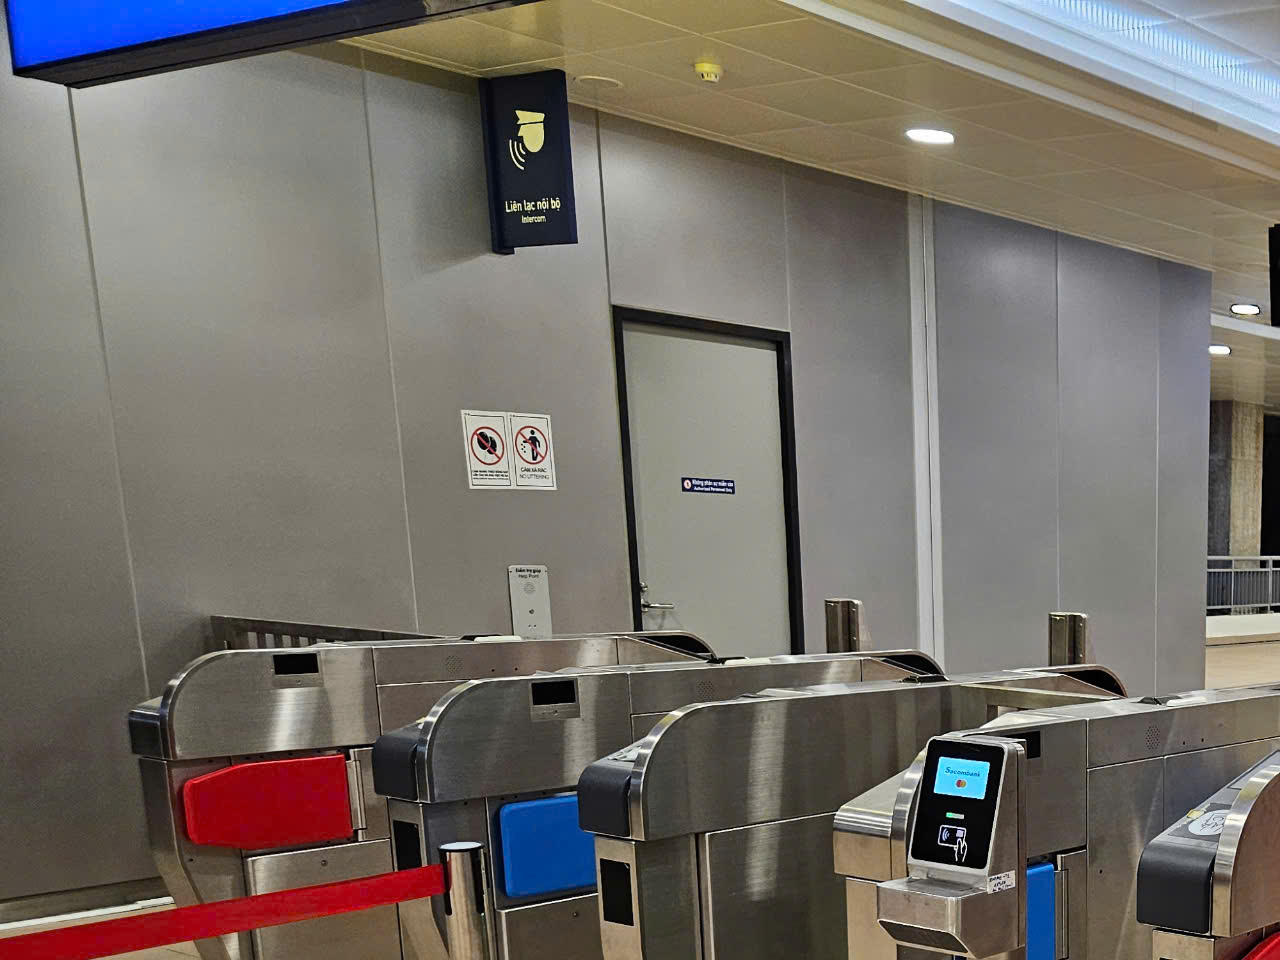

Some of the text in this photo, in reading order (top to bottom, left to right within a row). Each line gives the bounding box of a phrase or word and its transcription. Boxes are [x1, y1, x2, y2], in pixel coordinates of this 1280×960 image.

[505, 197, 561, 214] Liên lạc nội bộ
[521, 214, 547, 224] Intercom
[944, 766, 981, 777] Sacombank
